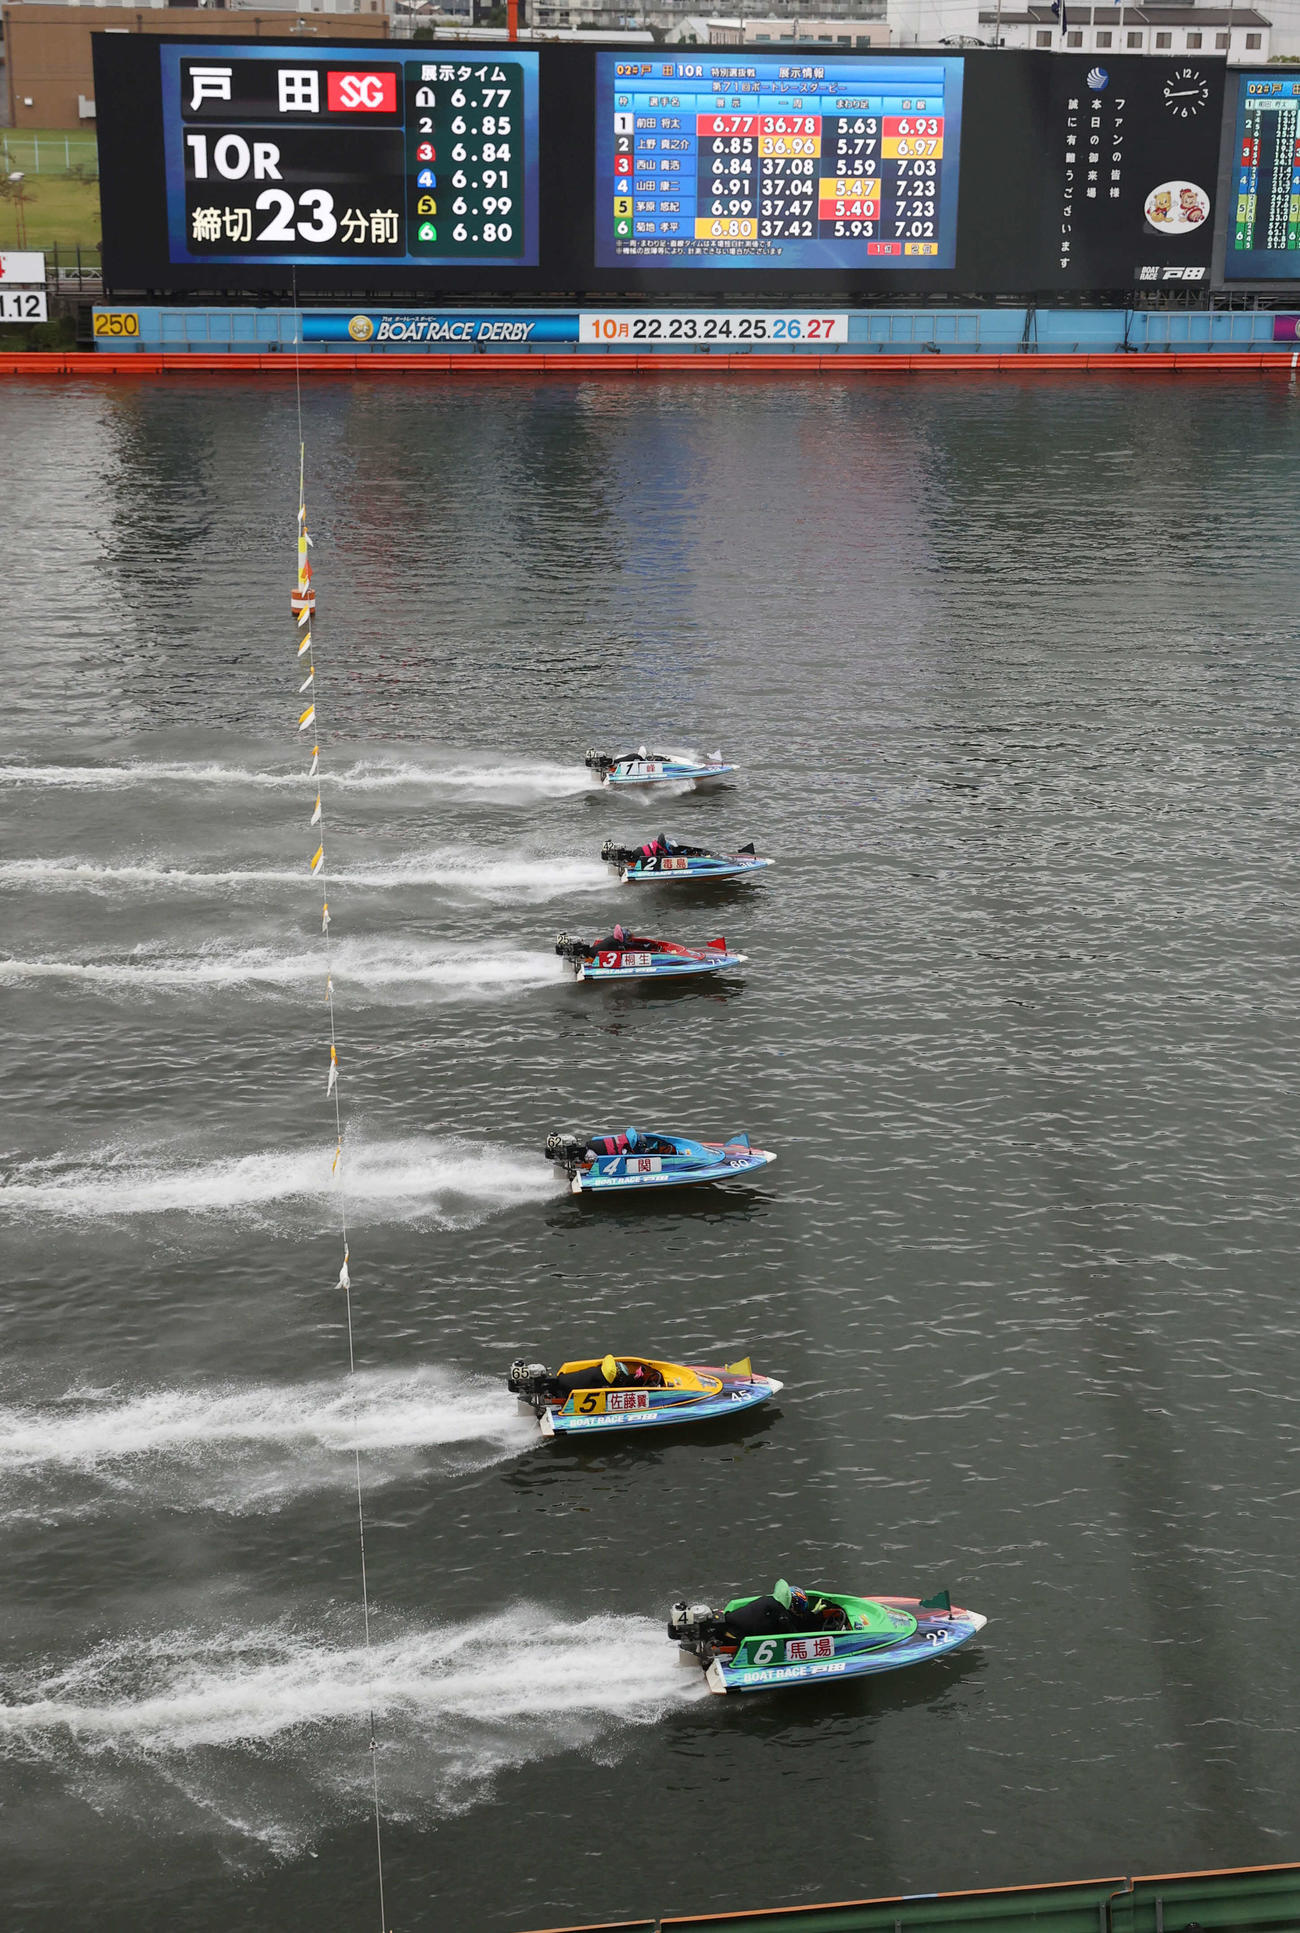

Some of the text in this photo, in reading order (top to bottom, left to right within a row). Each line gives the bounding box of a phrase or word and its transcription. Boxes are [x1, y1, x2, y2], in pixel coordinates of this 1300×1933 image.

[421, 64, 507, 82] 展示タイム
[678, 65, 703, 77] 10R
[778, 66, 825, 80] 展示情報
[1183, 69, 1192, 78] 12
[340, 75, 384, 108] SG
[421, 88, 512, 109] 1 6.77
[1202, 88, 1209, 98] 3
[649, 96, 680, 107] 選手名
[836, 98, 869, 110] まわり足
[1181, 108, 1188, 118] 6
[419, 116, 512, 135] 2 6.85
[620, 117, 626, 130] 1
[712, 117, 753, 133] 6.77
[763, 117, 815, 134] 36.78
[837, 118, 877, 134] 5.63
[898, 119, 938, 135] 6.93
[1245, 119, 1252, 128] 2
[419, 143, 512, 162] 3 6.84
[618, 138, 629, 151] 2
[637, 138, 656, 150] 上野
[712, 138, 753, 154] 6.85
[762, 138, 815, 154] 36.96
[837, 139, 877, 155] 5.77
[897, 139, 937, 155] 6.97
[1086, 98, 1103, 199] 本日の御来場
[1109, 98, 1126, 199] ファンの皆様
[1243, 147, 1250, 157] 3
[187, 134, 284, 180] 10R
[618, 158, 629, 173] 3
[637, 160, 656, 171] 西山
[711, 158, 753, 174] 6.84
[762, 159, 814, 175] 37.08
[836, 159, 876, 176] 5.59
[897, 160, 937, 176] 7.03
[418, 170, 509, 189] 4 6.91
[617, 179, 629, 193] 4
[636, 181, 656, 191] 山田
[711, 179, 750, 195] 6.91
[761, 179, 813, 196] 37.04
[835, 180, 875, 196] 5.47
[896, 180, 936, 197] 7.23
[1240, 176, 1247, 184] 4
[420, 197, 512, 216] 5 6.99
[619, 200, 628, 213] 5
[711, 199, 752, 216] 6.99
[761, 200, 813, 216] 37.47
[835, 201, 874, 217] 5.40
[895, 201, 935, 217] 7.23
[1239, 204, 1246, 213] 5
[1291, 204, 1298, 213] 5
[421, 223, 512, 242] 6 6.80
[617, 221, 629, 235] 6
[710, 220, 752, 236] 6.80
[761, 220, 813, 237] 37.42
[834, 221, 873, 237] 5.93
[895, 221, 934, 237] 7.02
[1236, 231, 1243, 240] 6
[1289, 232, 1296, 240] 6
[1141, 266, 1160, 274] BOAT
[1162, 267, 1206, 280] 戸田
[95, 314, 138, 337] 250
[477, 323, 536, 341] DERBY
[626, 763, 634, 775] 1
[643, 857, 657, 870] 2
[557, 935, 570, 944] 25
[603, 952, 650, 967] 3 桐生
[547, 1136, 562, 1148] 62
[602, 1158, 622, 1175] 4
[511, 1367, 529, 1380] 65
[579, 1392, 598, 1413] 5
[730, 1389, 753, 1402] 45
[570, 1416, 596, 1427] BOAT
[597, 1415, 624, 1425] RACE
[677, 1611, 689, 1624] 4
[926, 1629, 952, 1648] 22
[753, 1638, 832, 1665] 6 馬場
[744, 1668, 774, 1682] BOAT
[775, 1666, 808, 1680] RACE
